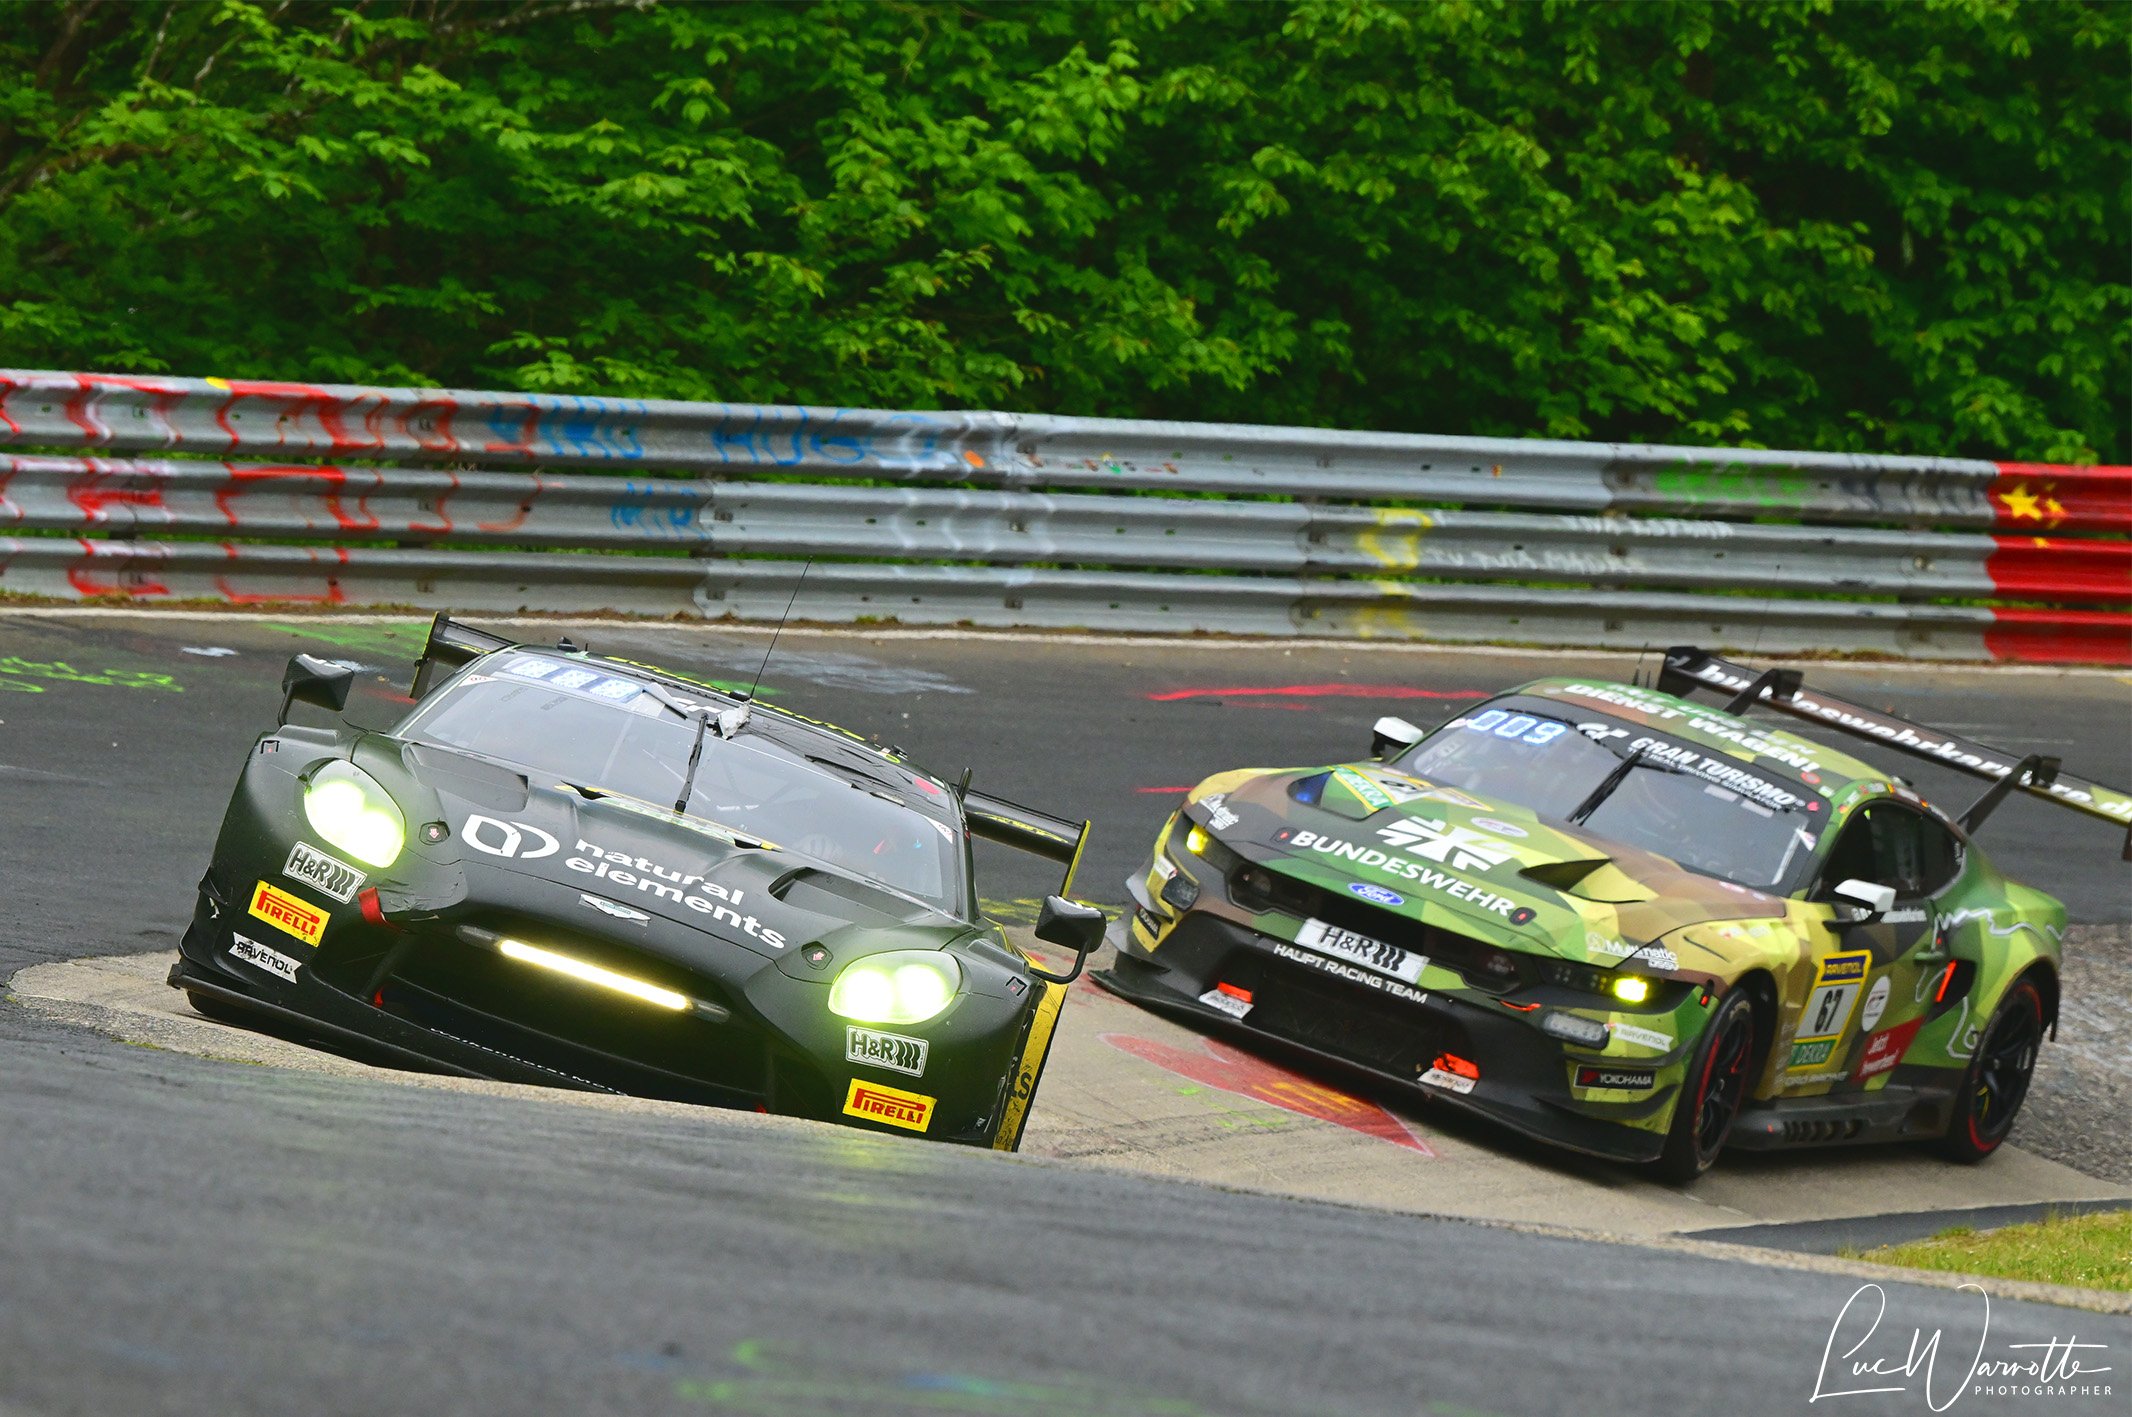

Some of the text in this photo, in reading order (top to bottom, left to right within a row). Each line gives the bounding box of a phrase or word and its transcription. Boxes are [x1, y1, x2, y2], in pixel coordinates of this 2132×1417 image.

[1466, 709, 1567, 745] 009
[1564, 684, 1686, 719] DIENST
[1688, 718, 1822, 774] WAGEN!
[1630, 737, 1701, 765] GRAN
[1699, 757, 1798, 806] TURISMO
[565, 857, 787, 949] elements
[574, 838, 745, 906] natural
[1290, 831, 1518, 916] BUNDESWEHR
[256, 889, 320, 937] PIRELLI
[1274, 943, 1428, 1005] HAUPT RACING TEAM
[851, 1087, 928, 1125] PIRELLI
